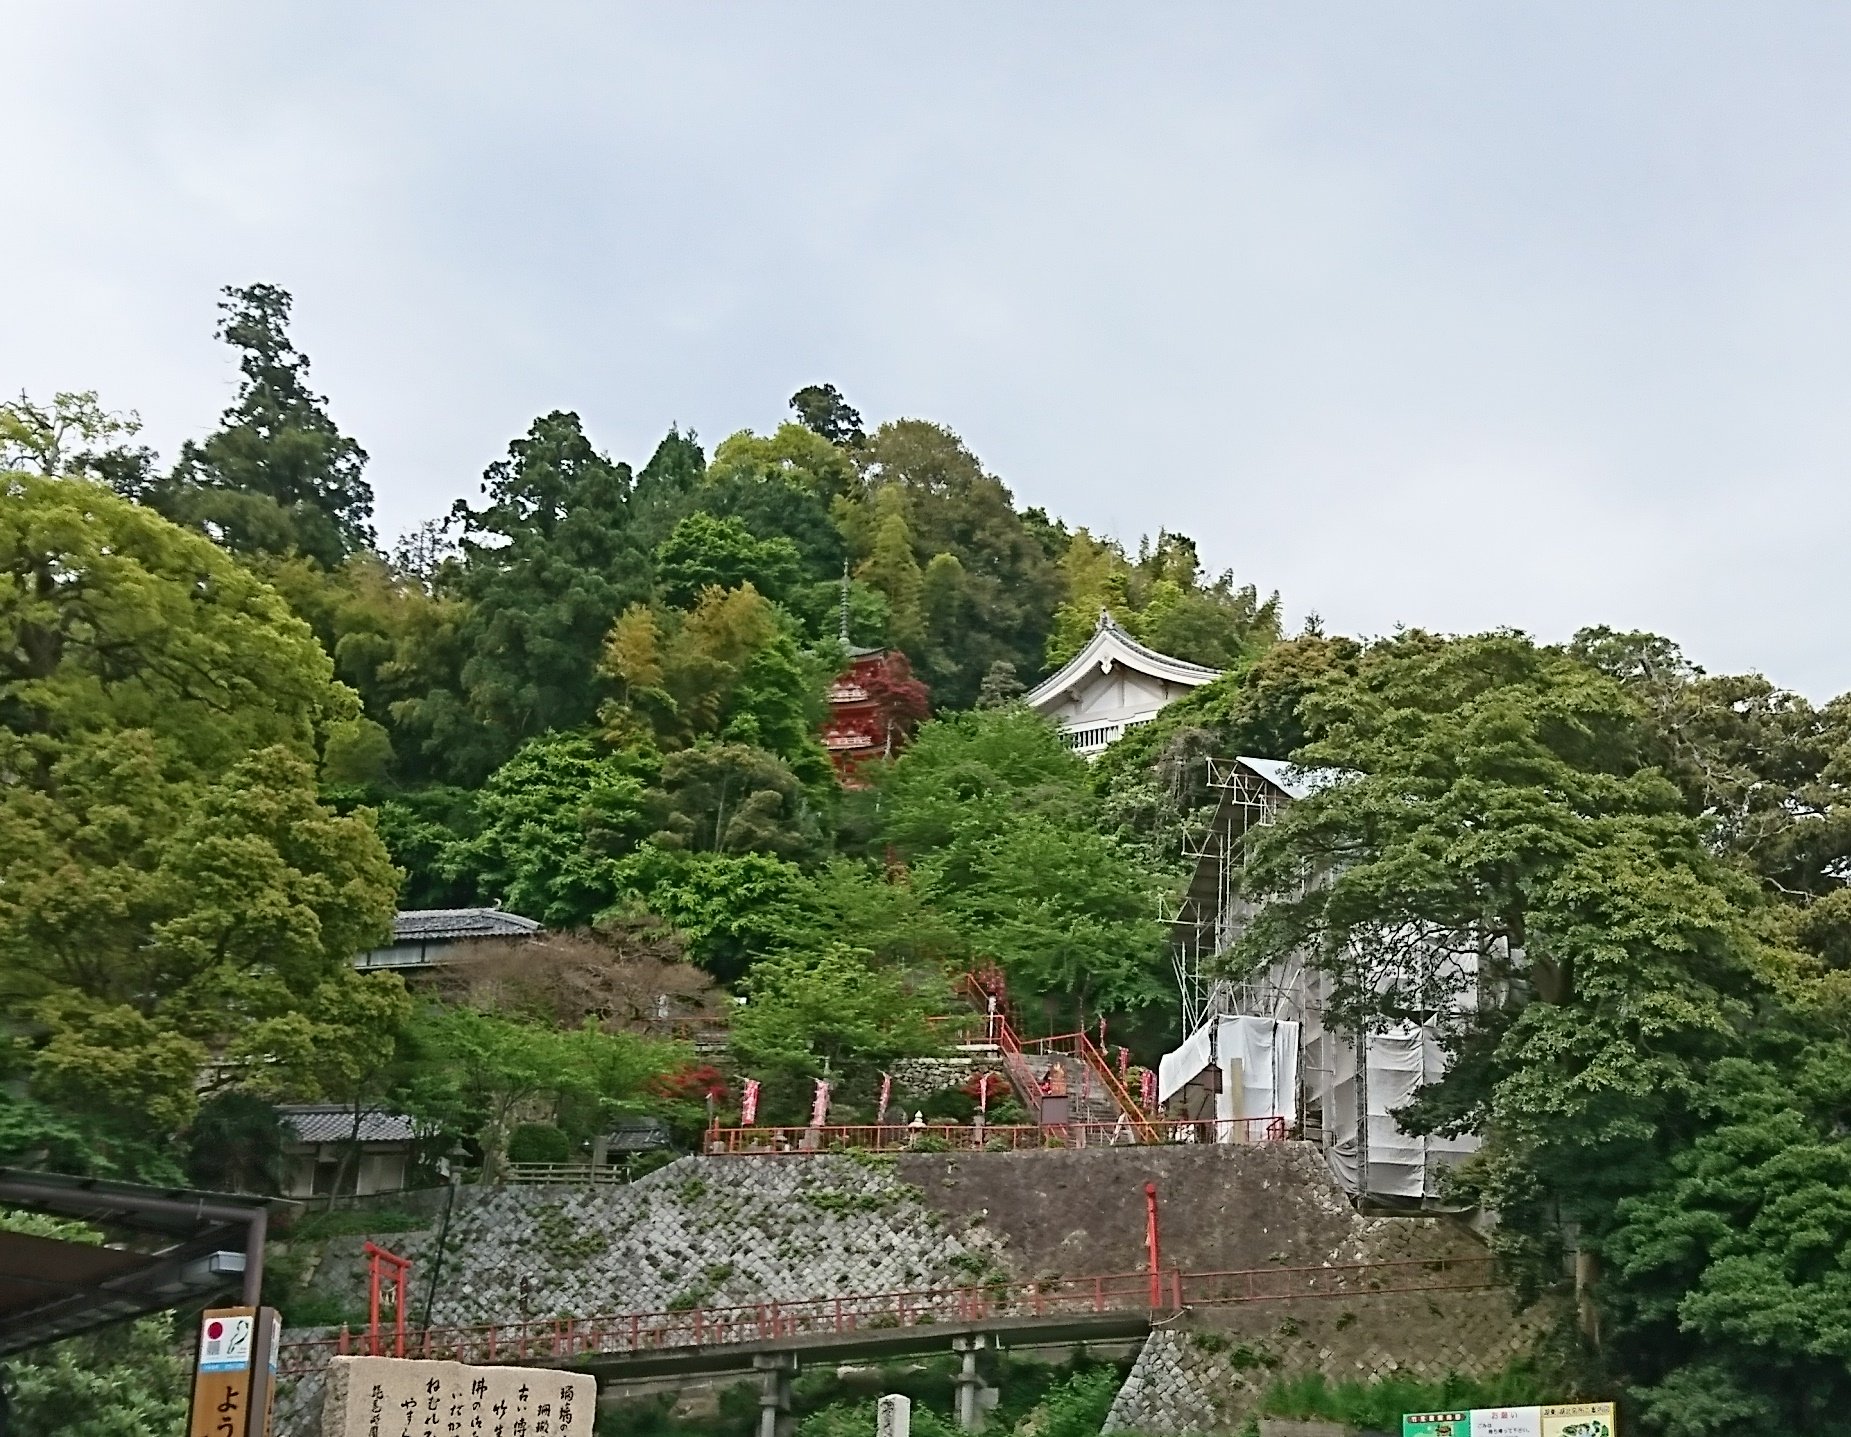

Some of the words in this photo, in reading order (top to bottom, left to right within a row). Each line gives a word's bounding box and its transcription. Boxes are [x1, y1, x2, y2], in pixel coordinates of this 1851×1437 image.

[217, 1385, 239, 1437] よう
[447, 1393, 465, 1437] いだか
[535, 1404, 551, 1437] 珊瑚
[558, 1385, 574, 1437] 瑠璃の
[1491, 1411, 1518, 1420] お願い
